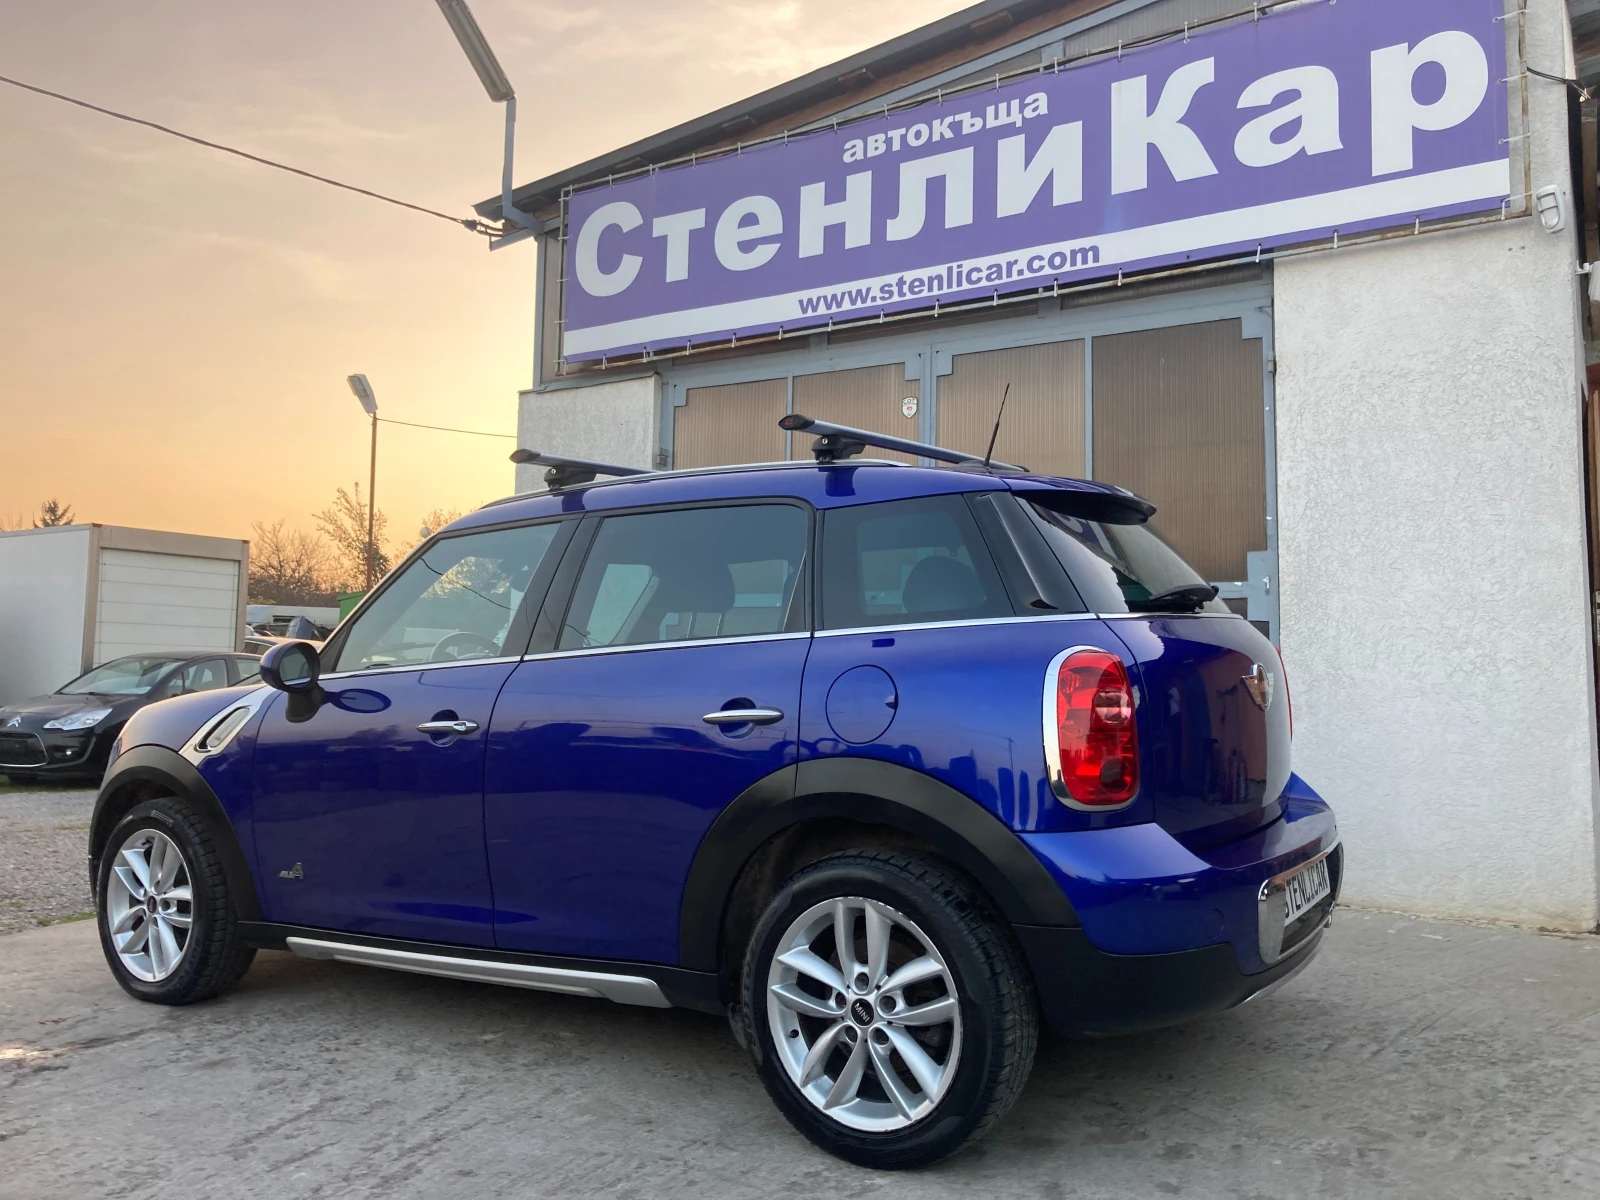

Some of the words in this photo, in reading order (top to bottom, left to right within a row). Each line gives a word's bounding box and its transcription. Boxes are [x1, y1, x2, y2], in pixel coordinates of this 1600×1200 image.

[842, 92, 1048, 163] автокъща
[575, 30, 1489, 297] СтенлиКар
[799, 244, 1100, 315] www.stenlicar.com
[854, 1002, 870, 1022] MINI
